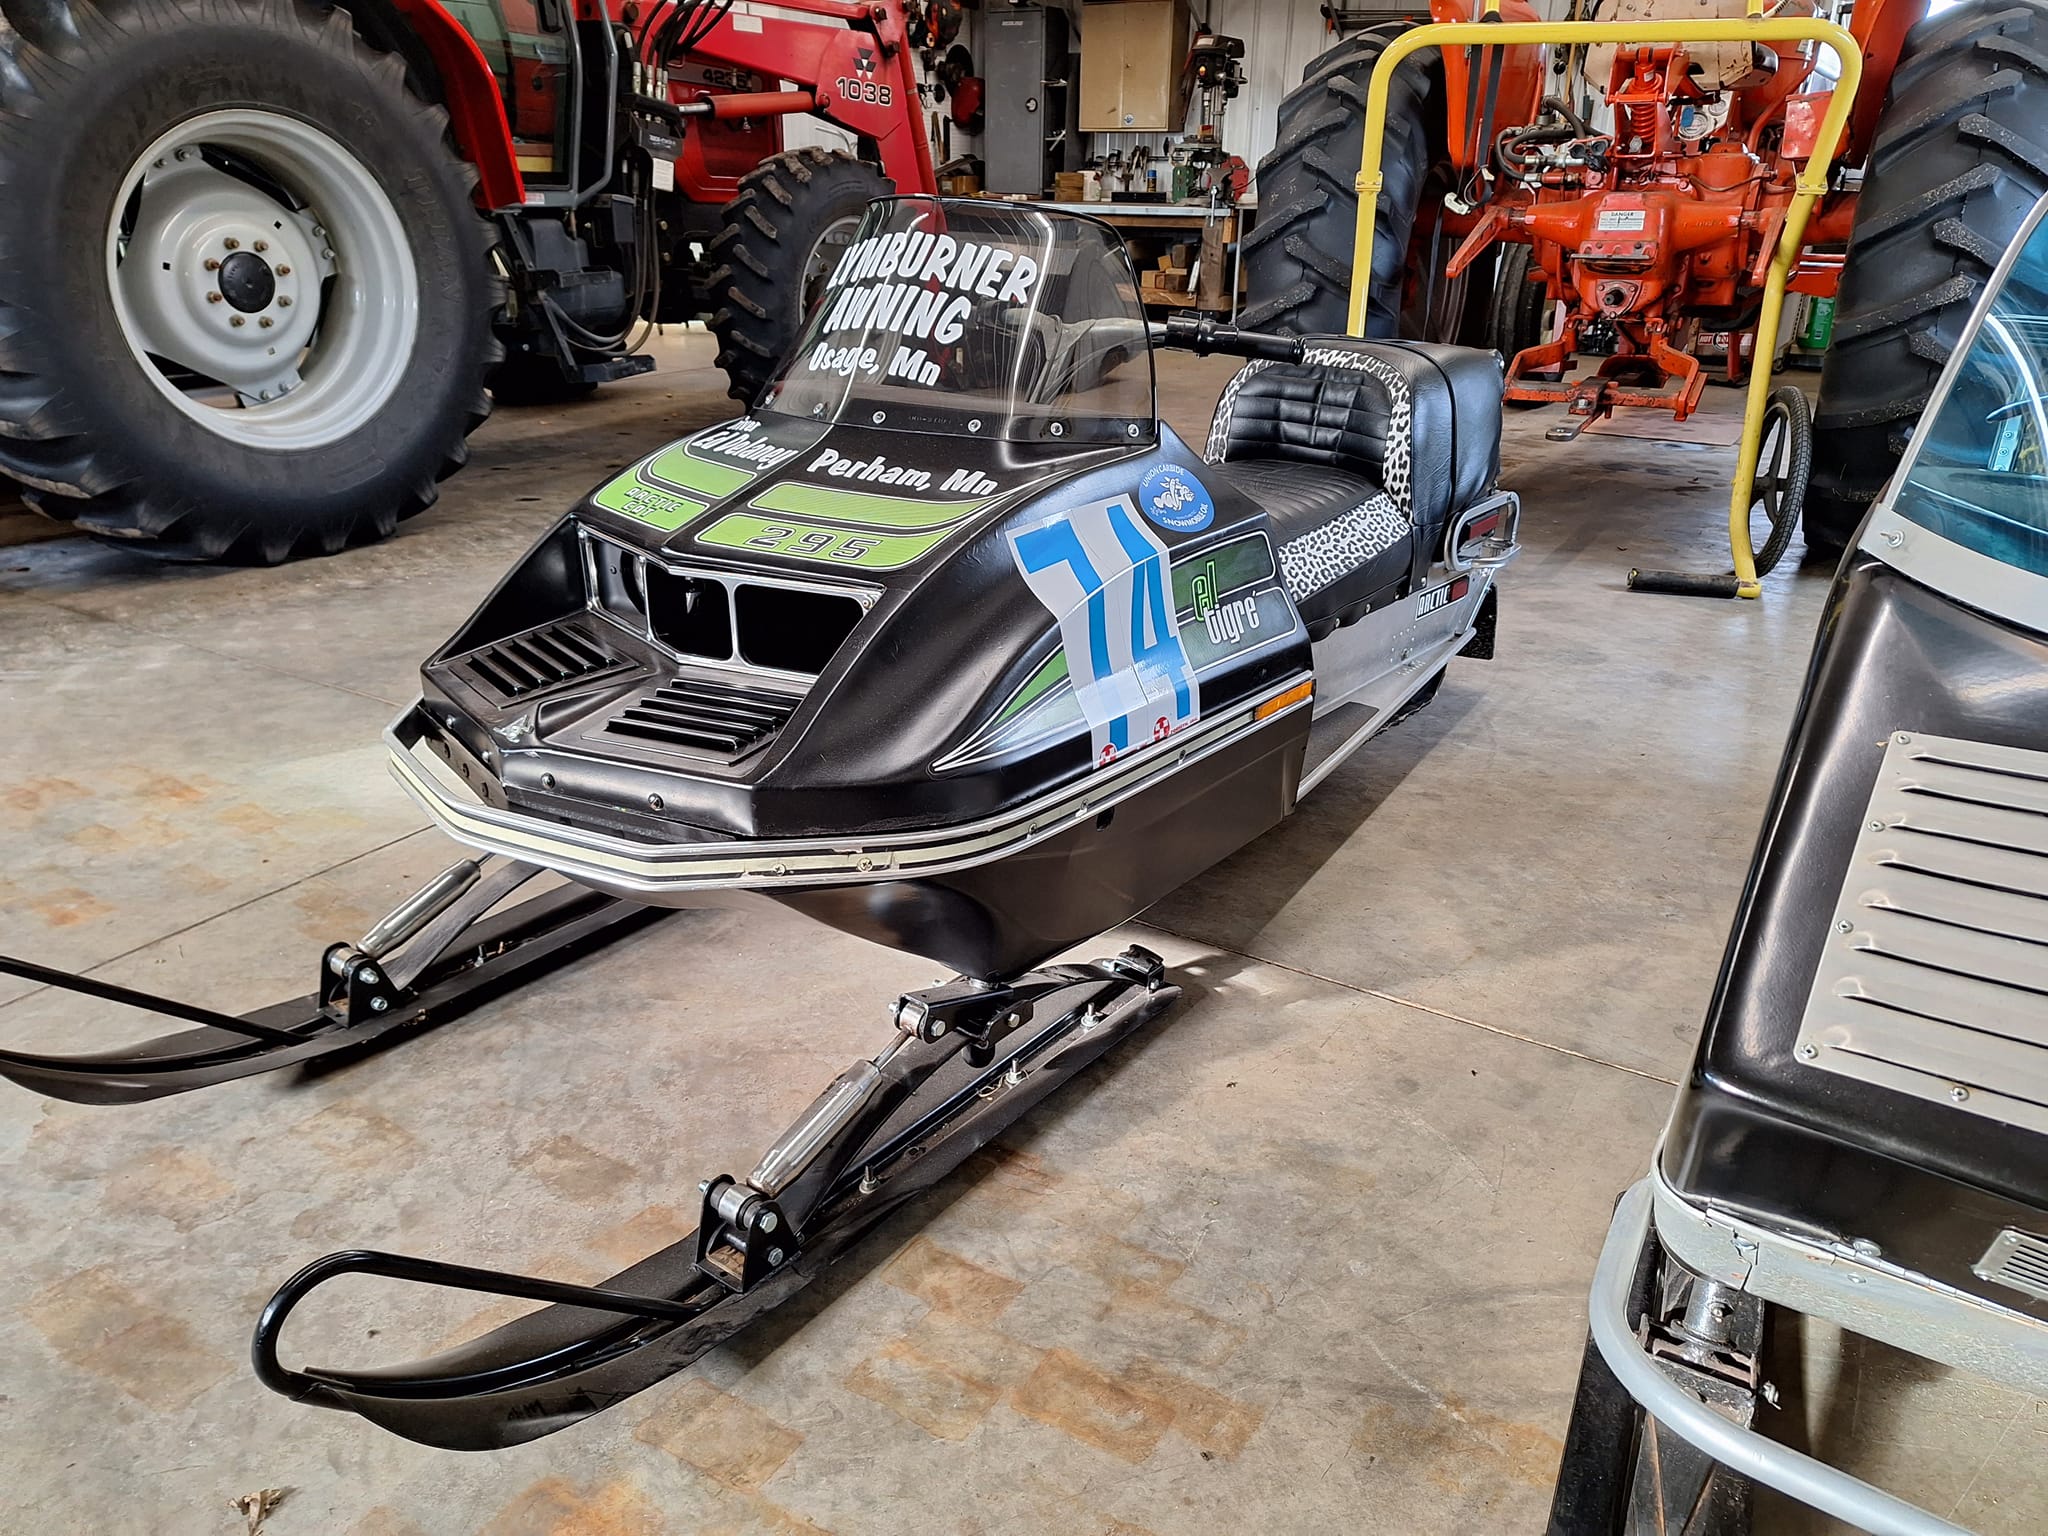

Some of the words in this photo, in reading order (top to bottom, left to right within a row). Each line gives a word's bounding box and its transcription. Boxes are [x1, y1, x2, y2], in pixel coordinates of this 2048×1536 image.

[836, 77, 892, 106] 1038
[826, 231, 1038, 304] LYMBURNER
[823, 285, 972, 344] AWNING
[808, 342, 880, 377] Osage,
[888, 346, 941, 386] Mn
[713, 433, 799, 470] Delaney
[806, 448, 931, 491] Perham,
[939, 467, 1001, 496] Mn
[1142, 466, 1160, 488] UNION
[620, 500, 655, 517] CAT
[624, 486, 685, 512] ARCTIC
[746, 525, 881, 560] 295
[1191, 559, 1219, 622] el
[1417, 584, 1451, 617] ARCTIC
[1014, 504, 1191, 751] 74
